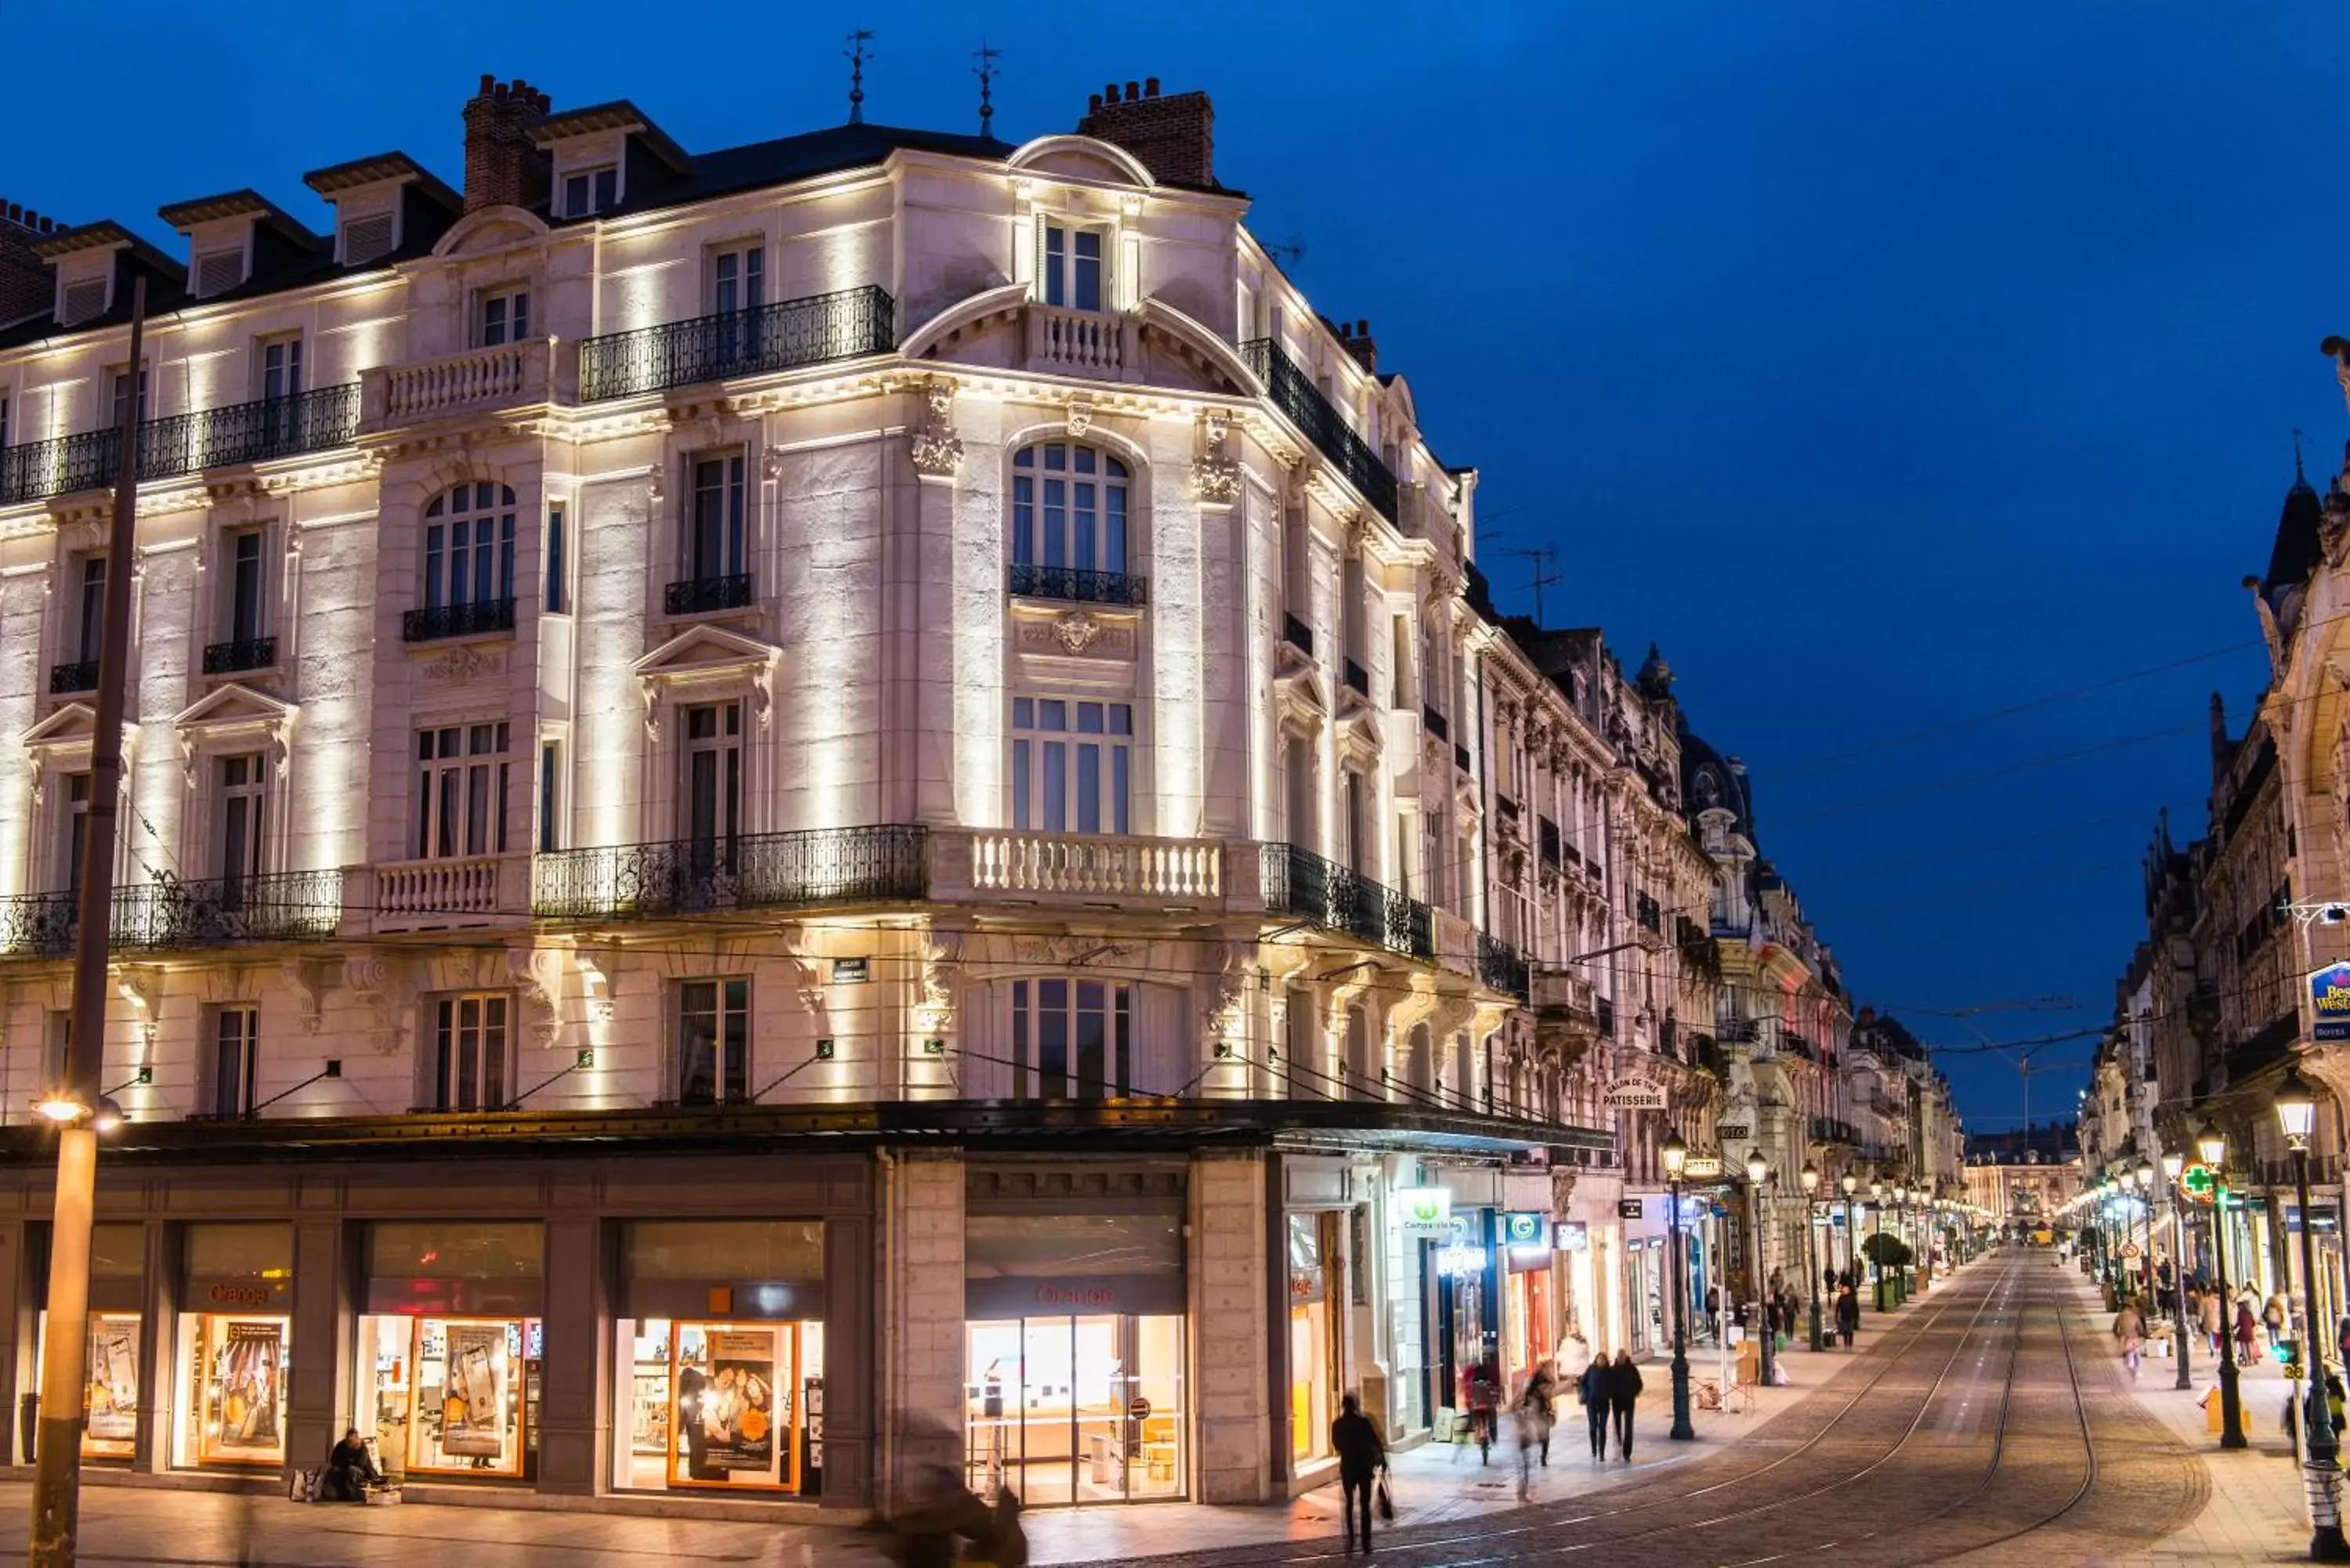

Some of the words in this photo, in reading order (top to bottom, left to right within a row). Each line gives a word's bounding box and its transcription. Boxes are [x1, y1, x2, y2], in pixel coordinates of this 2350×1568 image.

[1606, 1078, 1630, 1093] SALON
[1603, 1095, 1661, 1105] PATISSERIE
[1685, 1162, 1719, 1172] HOTEL
[1404, 1221, 1451, 1230] Campaile
[209, 1284, 269, 1306] Orange
[1036, 1282, 1114, 1306] Orange
